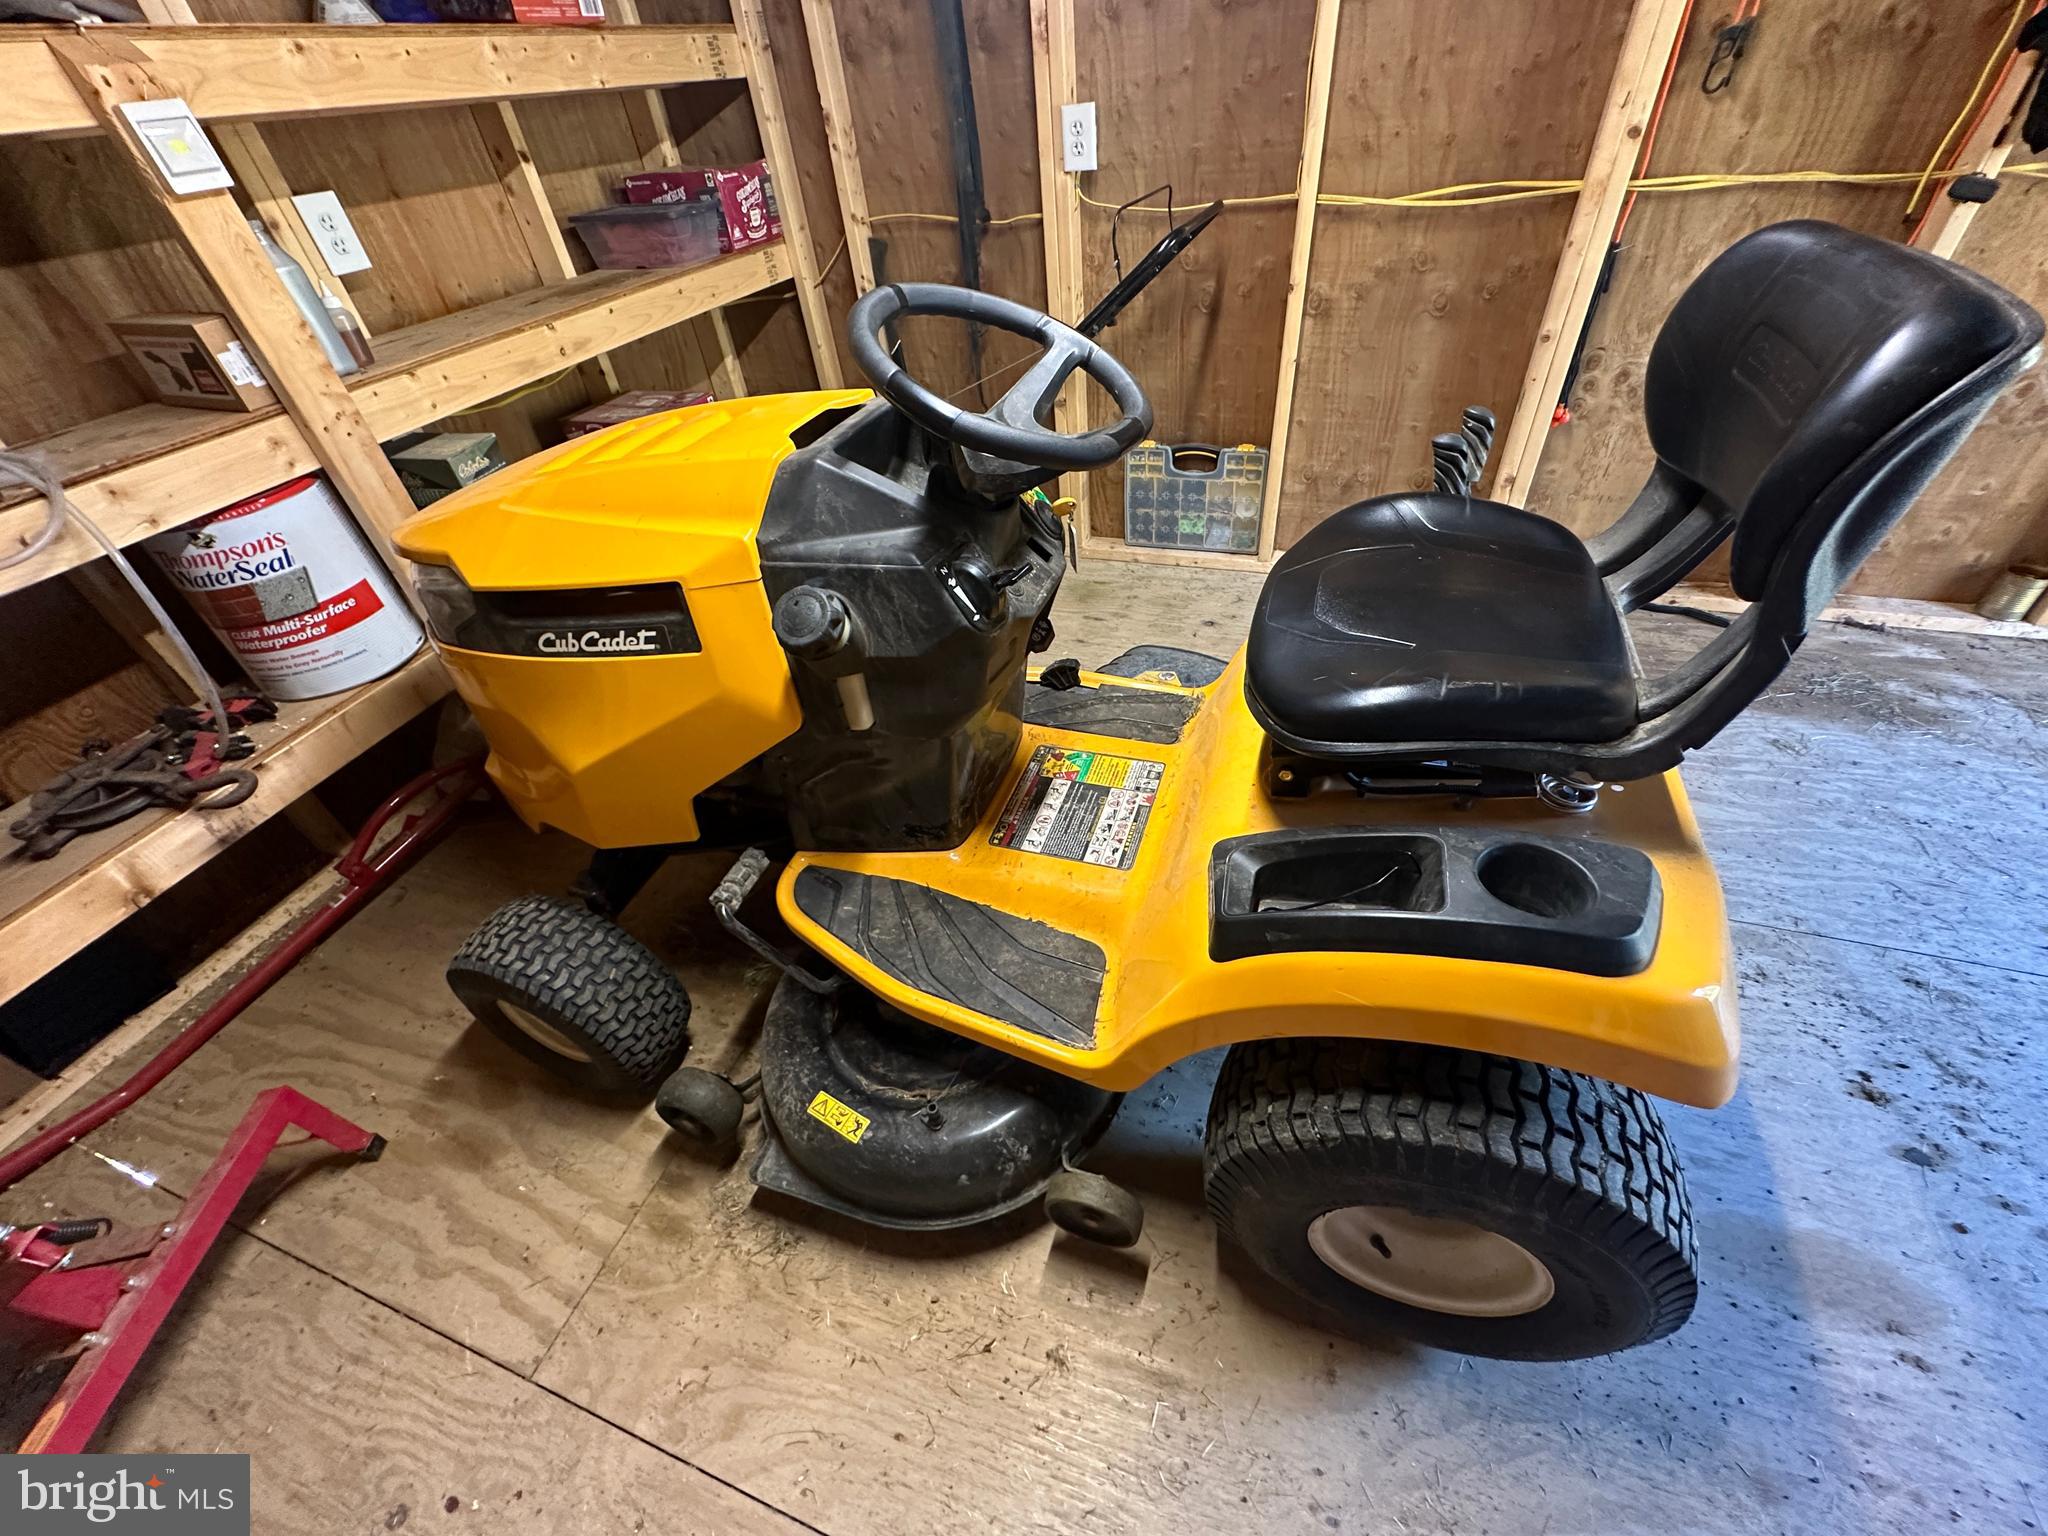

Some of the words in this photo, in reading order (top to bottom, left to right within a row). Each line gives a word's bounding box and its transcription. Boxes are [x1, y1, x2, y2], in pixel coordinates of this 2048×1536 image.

[231, 630, 262, 639] CLEAR
[262, 596, 356, 637] Multi-Surface
[235, 624, 328, 650] Waterproofer
